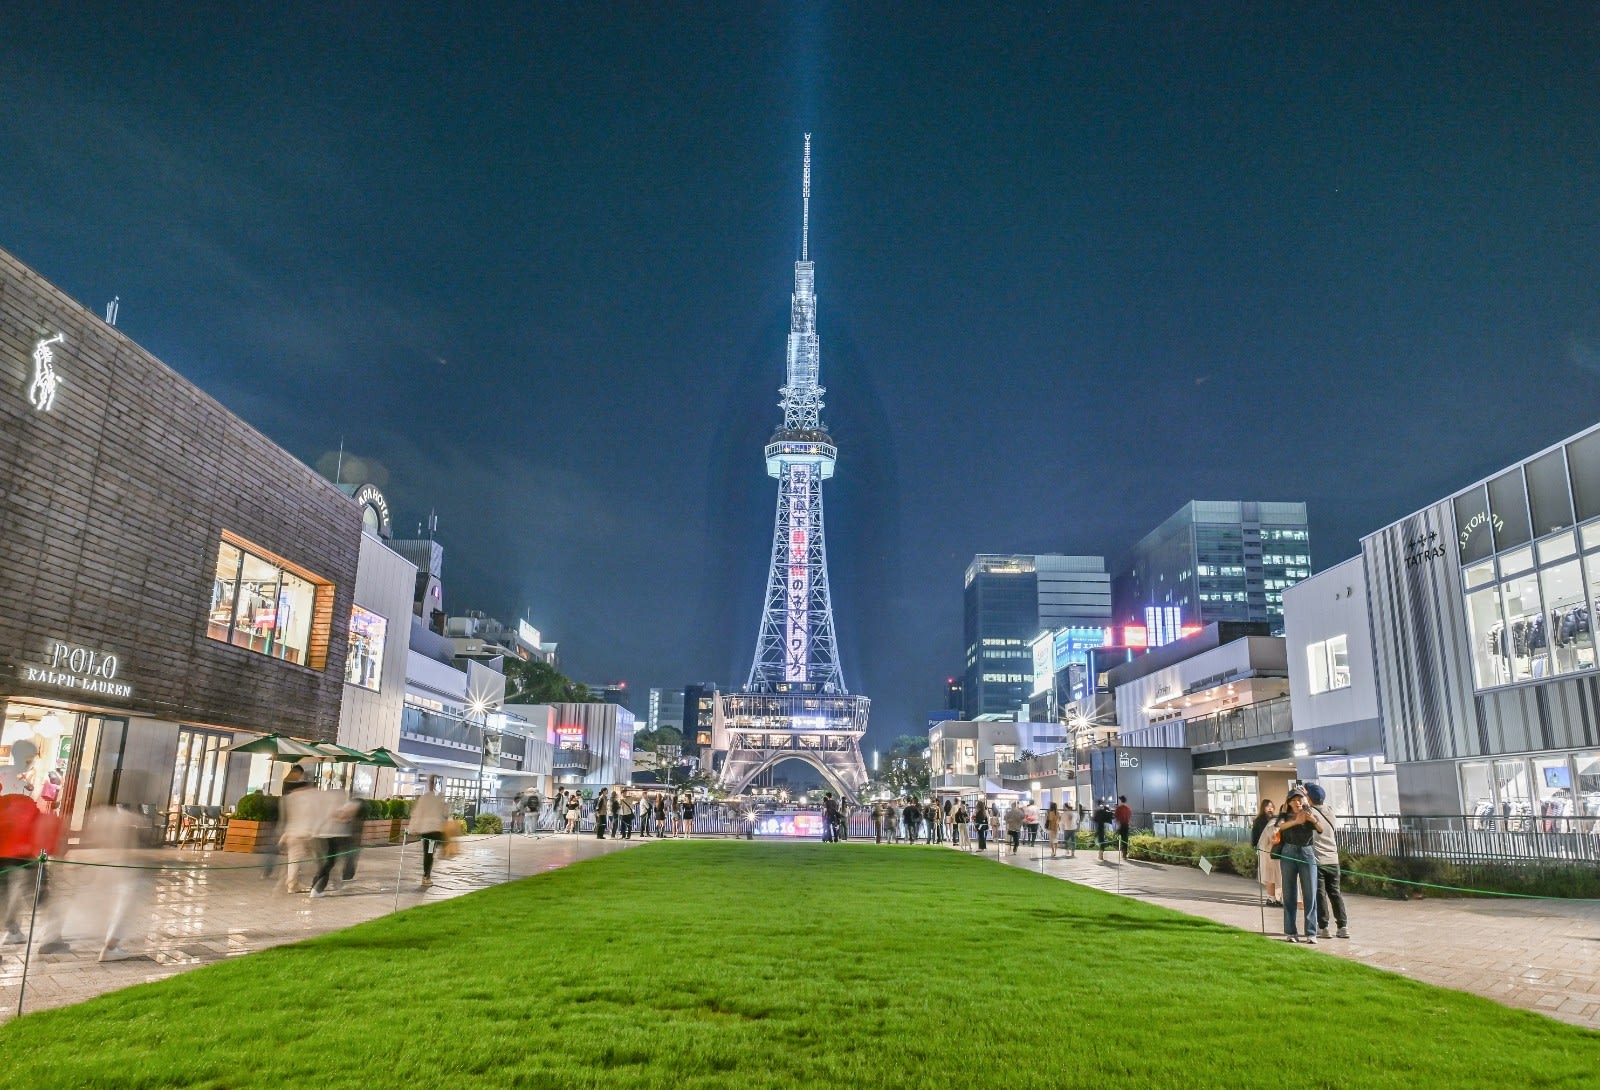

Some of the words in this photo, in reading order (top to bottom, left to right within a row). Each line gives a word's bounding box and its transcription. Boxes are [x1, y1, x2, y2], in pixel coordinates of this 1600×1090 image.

[358, 487, 373, 506] APA
[372, 489, 389, 527] HOTEL
[1404, 543, 1446, 569] TATRAS
[52, 643, 118, 680] POLO
[28, 667, 76, 688] RALPH
[82, 678, 132, 697] LAUREN
[1129, 757, 1139, 768] C
